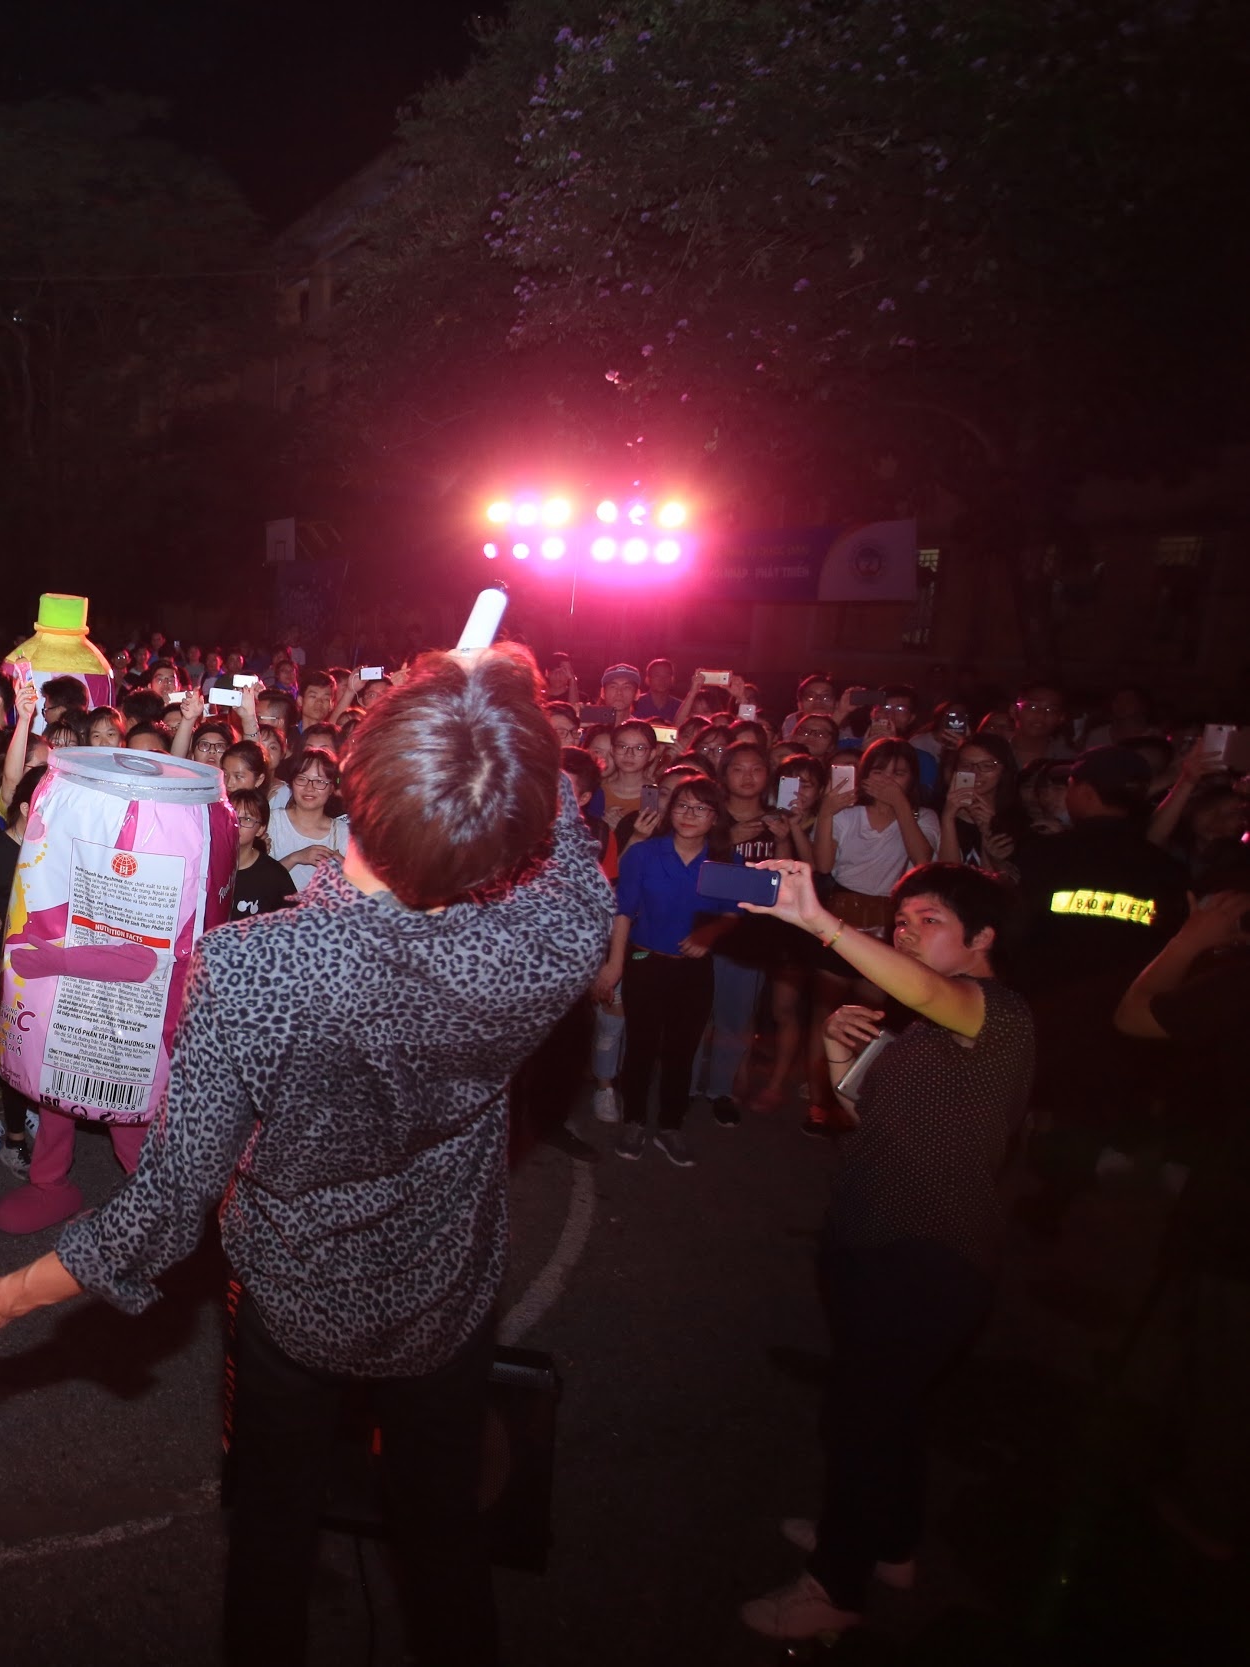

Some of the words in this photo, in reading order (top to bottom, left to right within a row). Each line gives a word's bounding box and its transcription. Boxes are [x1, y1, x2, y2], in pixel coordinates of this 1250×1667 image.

[95, 924, 125, 937] NUTRITION
[126, 933, 143, 942] FACTS
[17, 1011, 36, 1031] C
[54, 1089, 91, 1104] 934892
[97, 1100, 135, 1110] 010248
